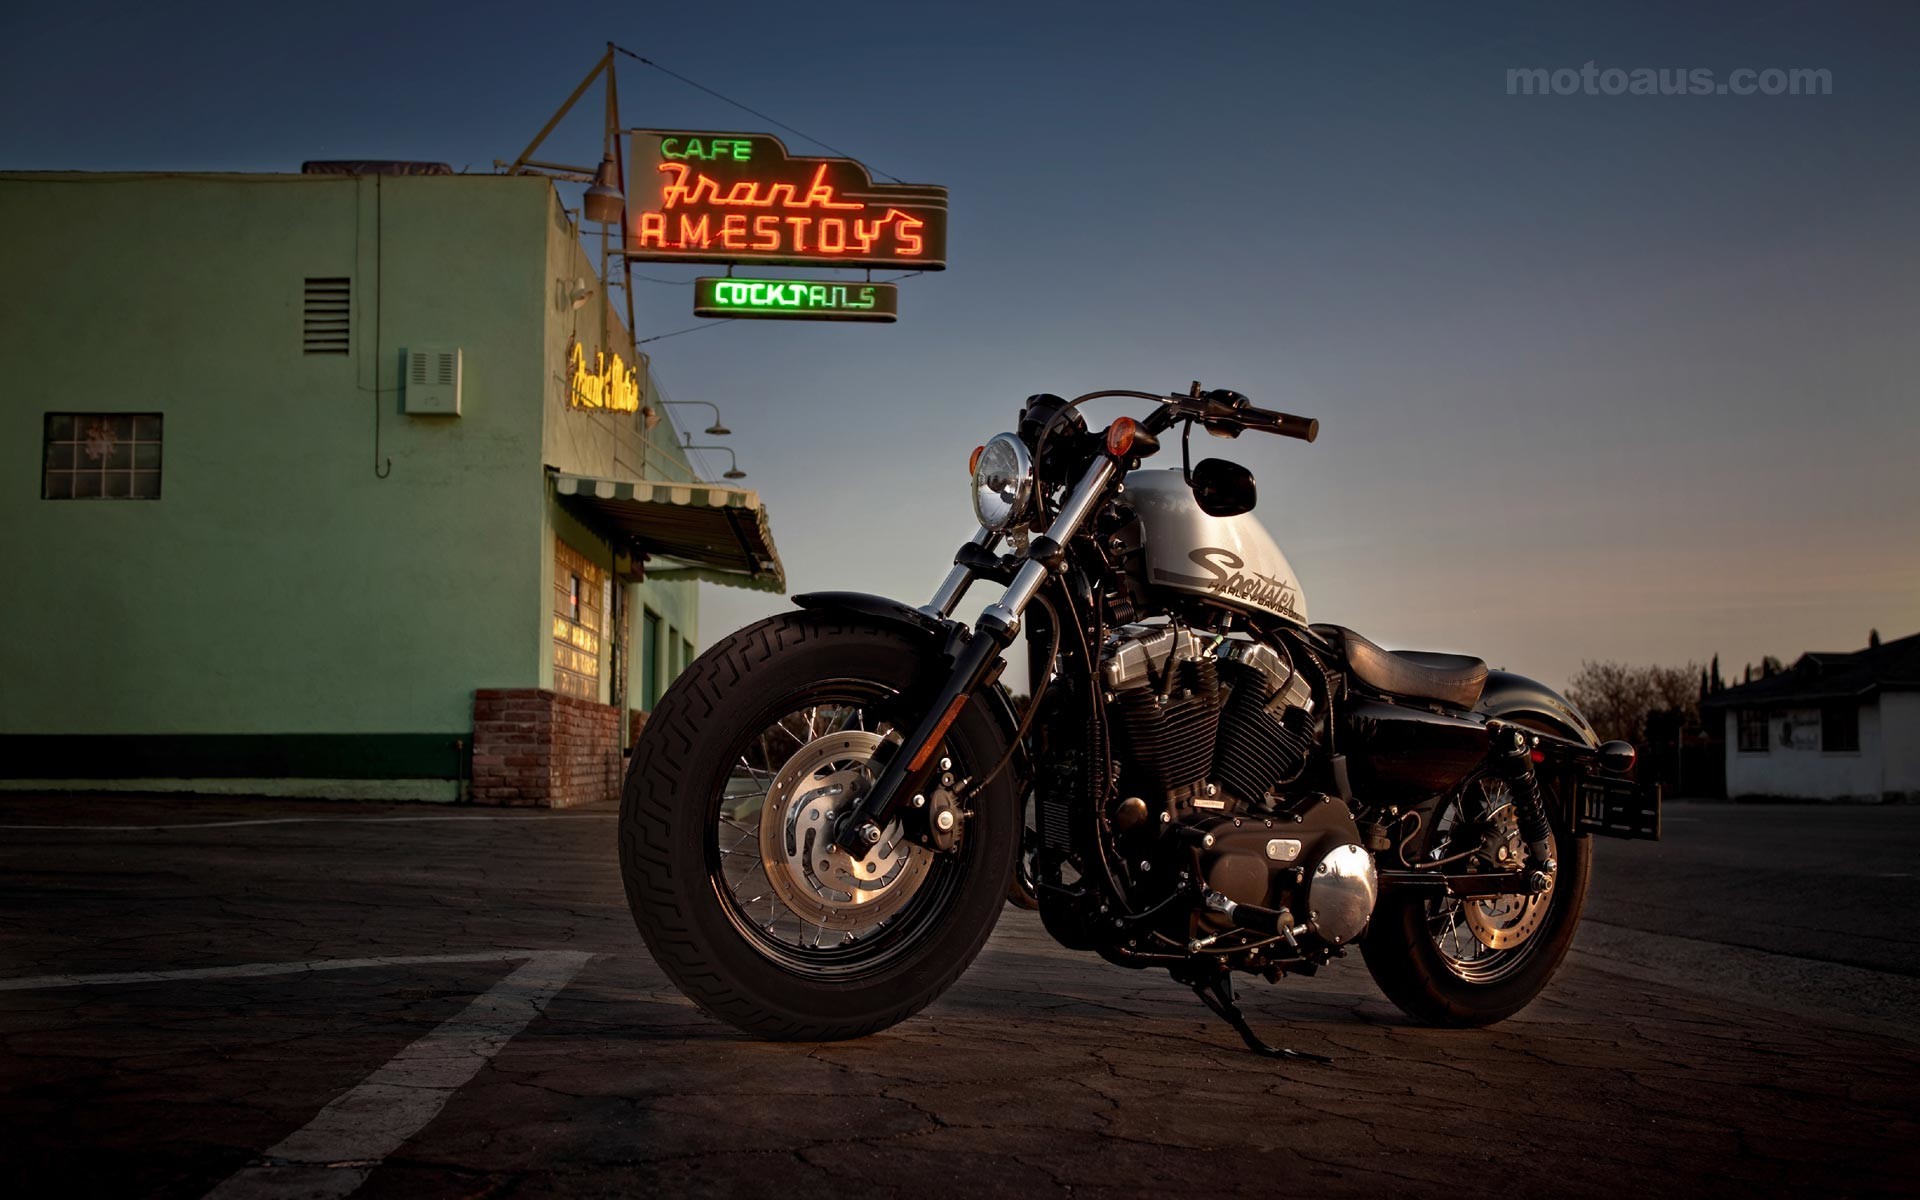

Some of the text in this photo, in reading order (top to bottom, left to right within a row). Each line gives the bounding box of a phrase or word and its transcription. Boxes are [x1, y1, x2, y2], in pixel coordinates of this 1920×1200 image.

[661, 138, 753, 161] CAFE
[658, 162, 865, 210] Frank
[640, 209, 924, 256] AMESTOY'S
[715, 281, 876, 309] COCKTAILS
[1187, 547, 1298, 612] Sportster
[1208, 581, 1299, 621] HARLEY-DAVIDSON
